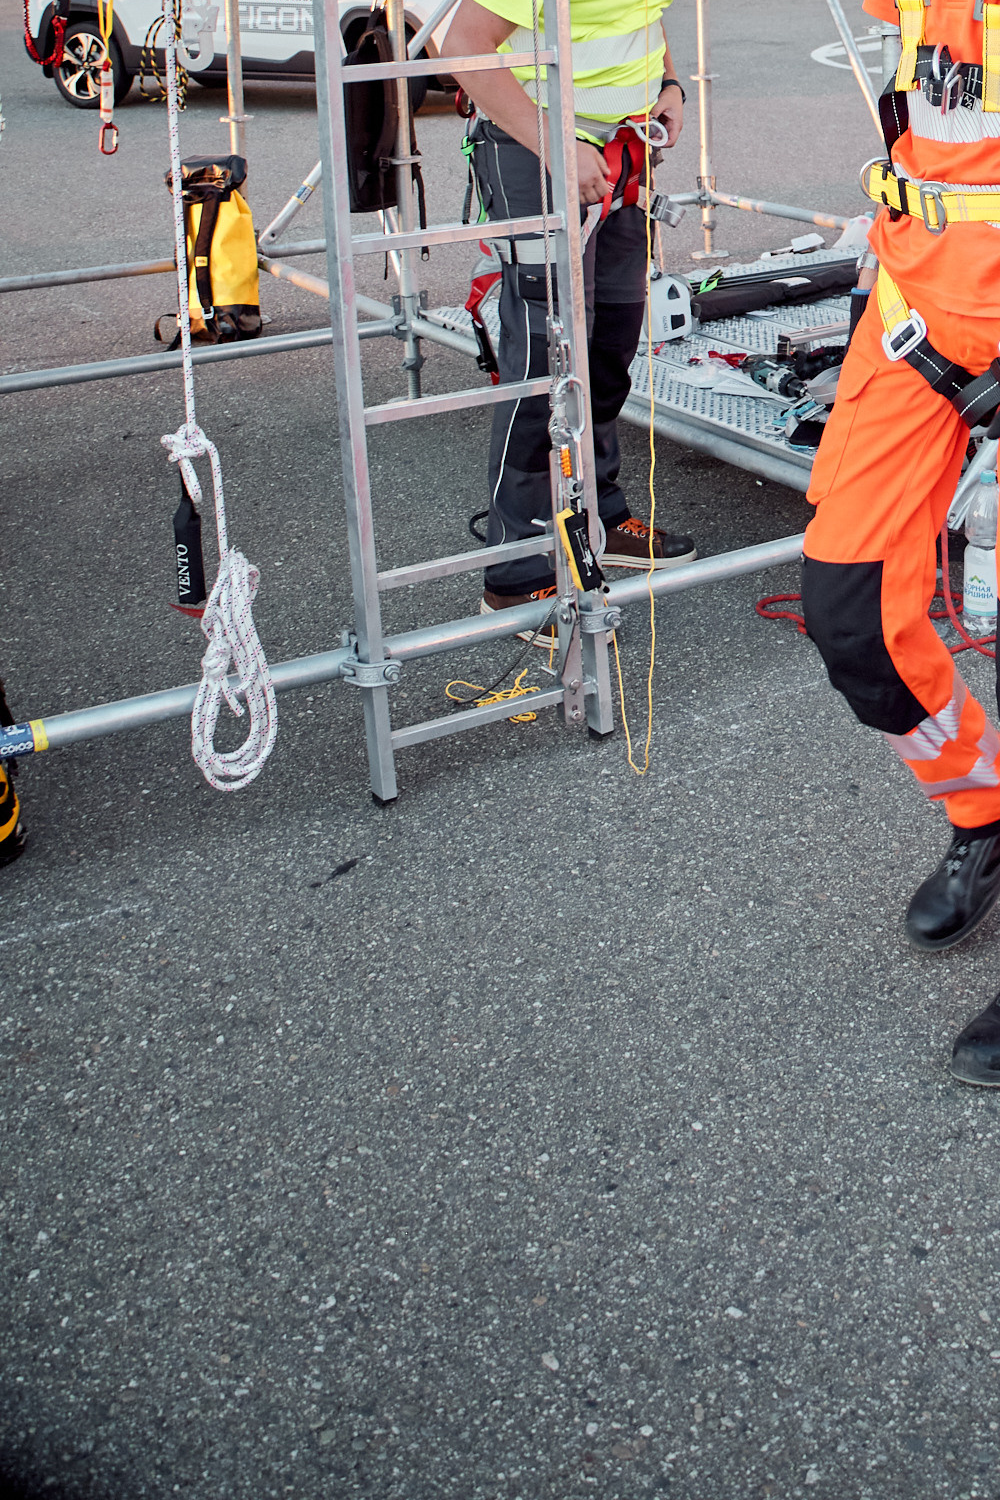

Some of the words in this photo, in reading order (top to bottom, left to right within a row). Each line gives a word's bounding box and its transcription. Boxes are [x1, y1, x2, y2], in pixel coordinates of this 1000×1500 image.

[176, 543, 191, 596] VENTO
[965, 588, 994, 599] ЕРШИНА
[0, 741, 34, 755] СОЮЗ
